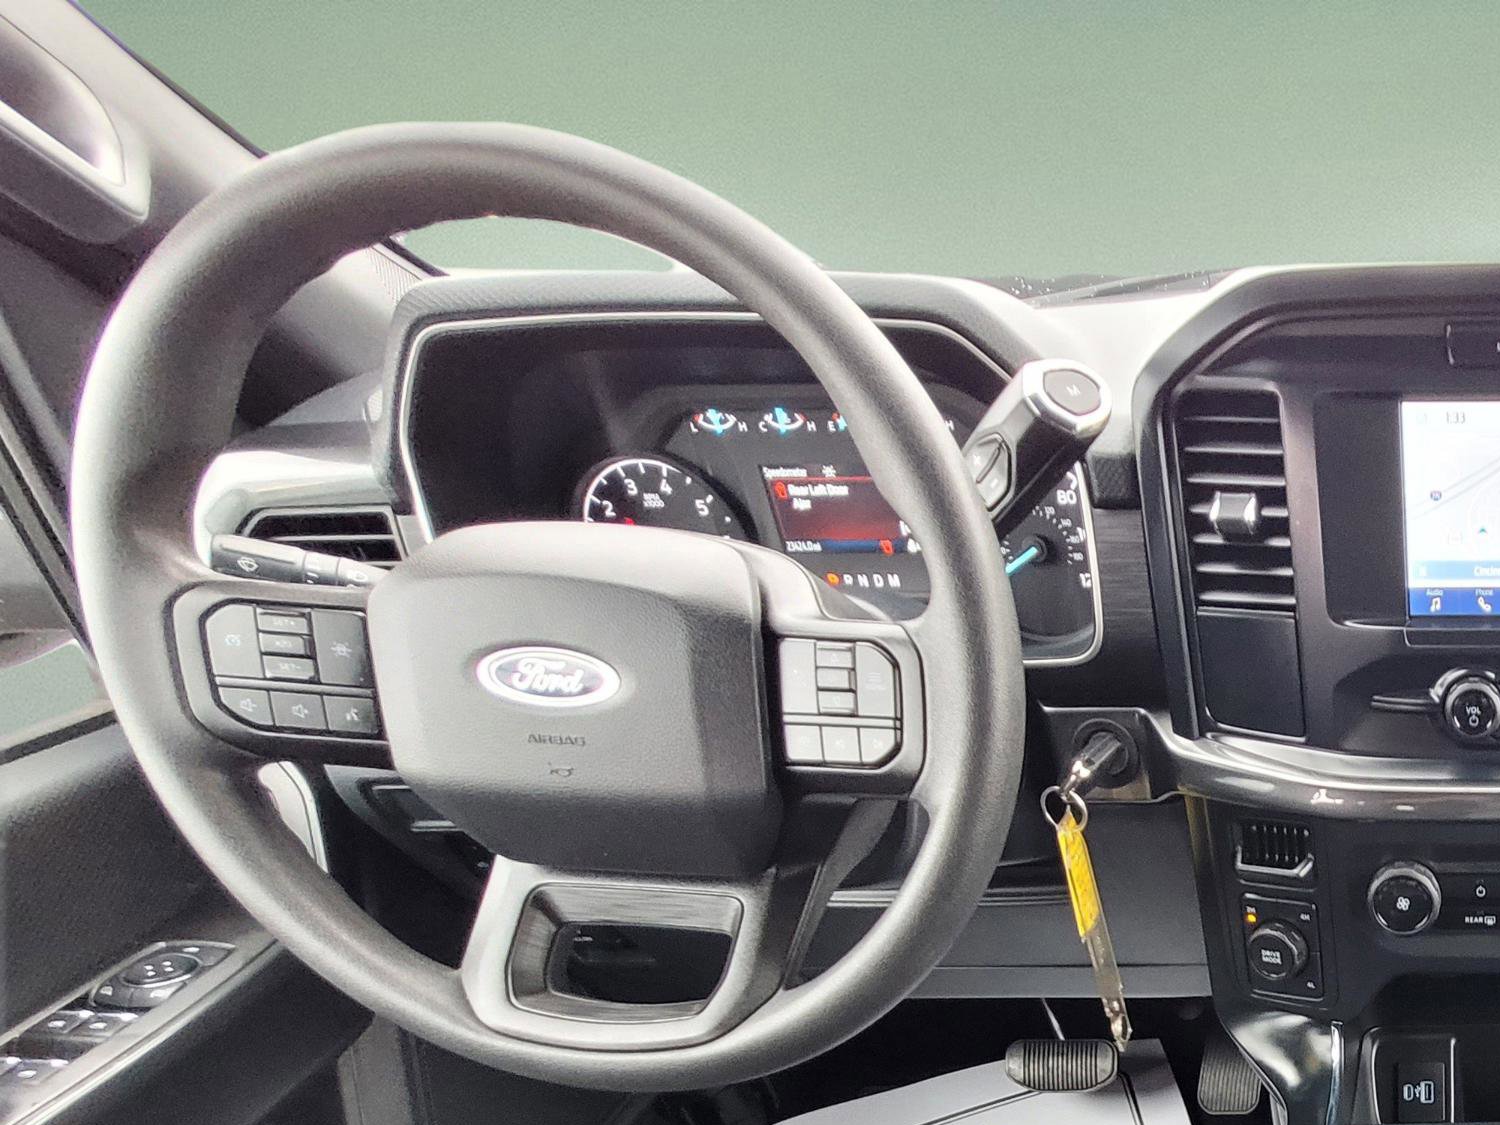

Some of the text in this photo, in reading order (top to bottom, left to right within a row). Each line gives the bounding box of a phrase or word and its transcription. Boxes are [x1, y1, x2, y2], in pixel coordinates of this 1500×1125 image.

[1066, 384, 1081, 397] M
[690, 421, 699, 433] L
[738, 421, 748, 432] H
[759, 420, 768, 432] C
[807, 421, 817, 432] H
[827, 420, 836, 432] E
[624, 478, 638, 495] 3
[660, 478, 673, 495] 4
[1057, 490, 1077, 505] 80
[602, 500, 616, 517] 2
[695, 499, 709, 516] 5
[857, 574, 869, 588] N
[873, 574, 885, 588] D
[887, 574, 900, 588] M
[512, 658, 584, 693] Ford
[1465, 705, 1481, 715] VOL
[527, 733, 586, 747] AIRBAG
[1465, 915, 1483, 924] REAR
